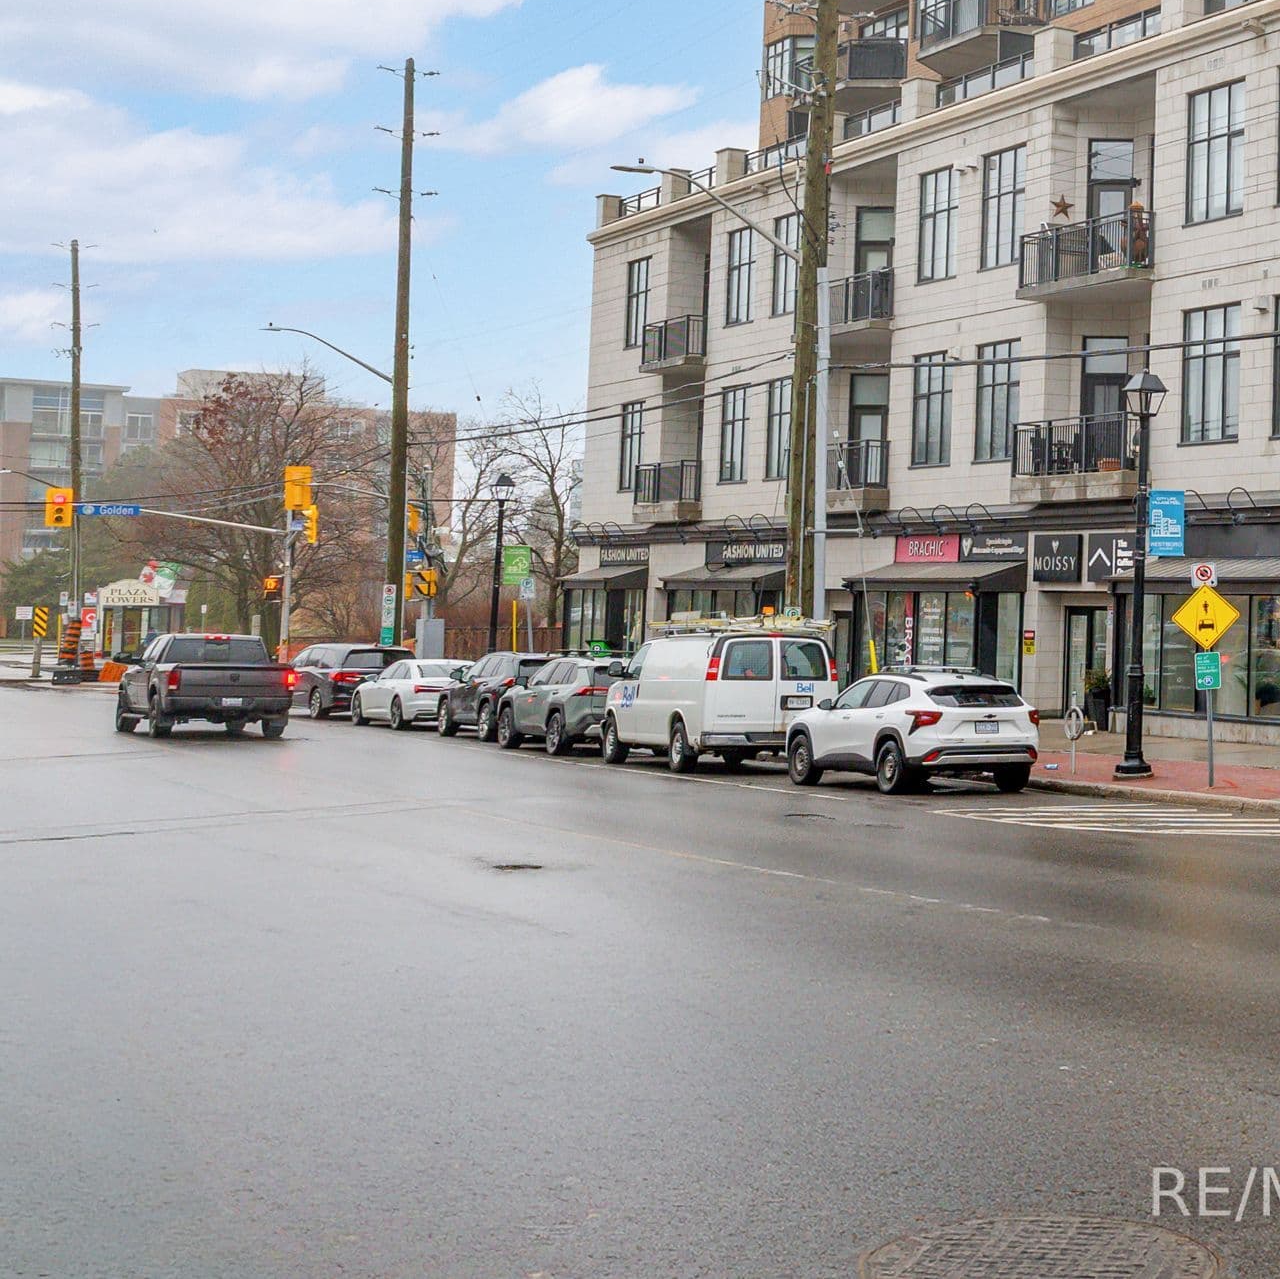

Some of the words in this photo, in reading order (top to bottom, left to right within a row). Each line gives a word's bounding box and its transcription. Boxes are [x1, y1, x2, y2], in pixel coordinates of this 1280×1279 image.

[99, 505, 134, 516] Golden
[601, 548, 626, 562] FASHION
[626, 547, 649, 561] UNITED
[722, 544, 754, 559] FASHION
[755, 544, 784, 558] UNITED
[908, 540, 944, 557] BRACHIC
[1034, 556, 1077, 571] MOISSY
[110, 588, 148, 596] PLAZA
[796, 683, 815, 694] Bell
